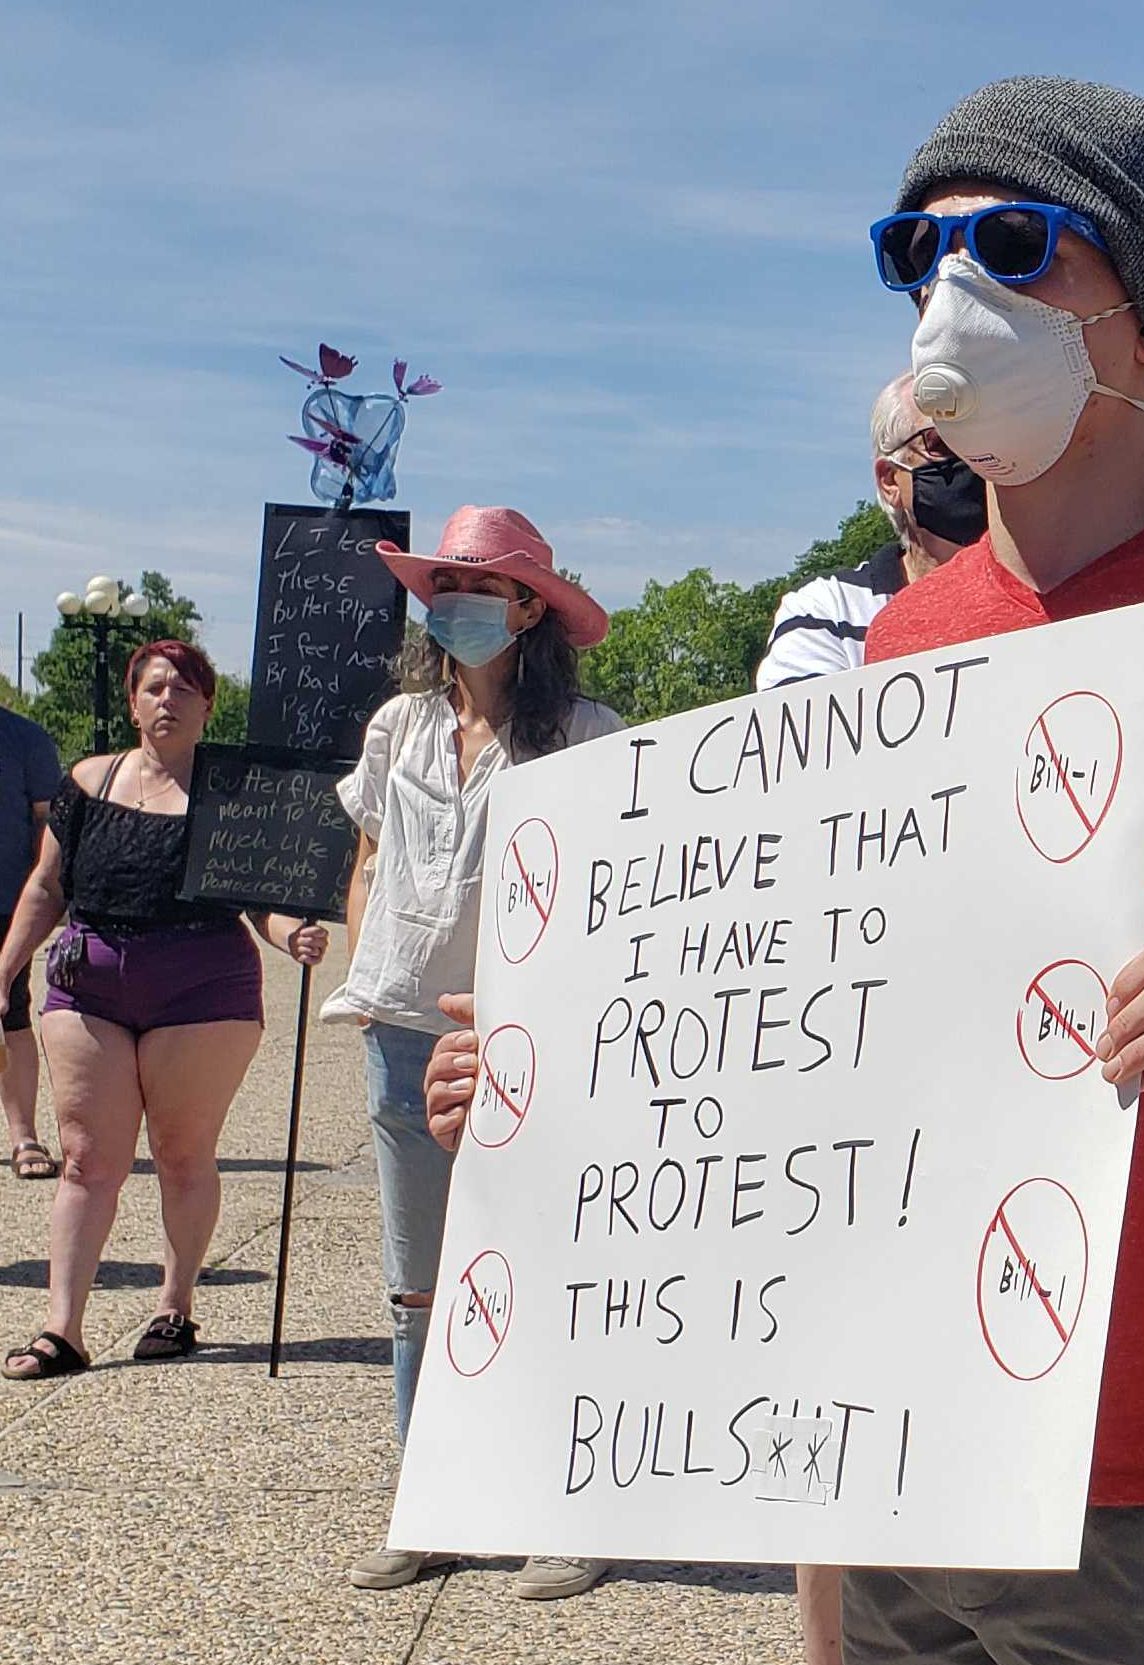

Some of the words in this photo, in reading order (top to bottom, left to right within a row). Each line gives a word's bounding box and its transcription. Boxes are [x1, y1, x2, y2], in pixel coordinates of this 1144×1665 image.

[269, 633, 286, 656] I
[621, 739, 657, 820] I
[688, 656, 990, 794] CANNOT
[587, 832, 783, 936] BELIEVE
[819, 784, 968, 868] THAT
[624, 932, 656, 983] I
[680, 920, 793, 975] HAVE
[823, 906, 887, 963] TO
[588, 979, 889, 1098] PROTEST
[649, 1096, 724, 1149] TO
[565, 1275, 686, 1345] THIS
[731, 1275, 787, 1343] IS
